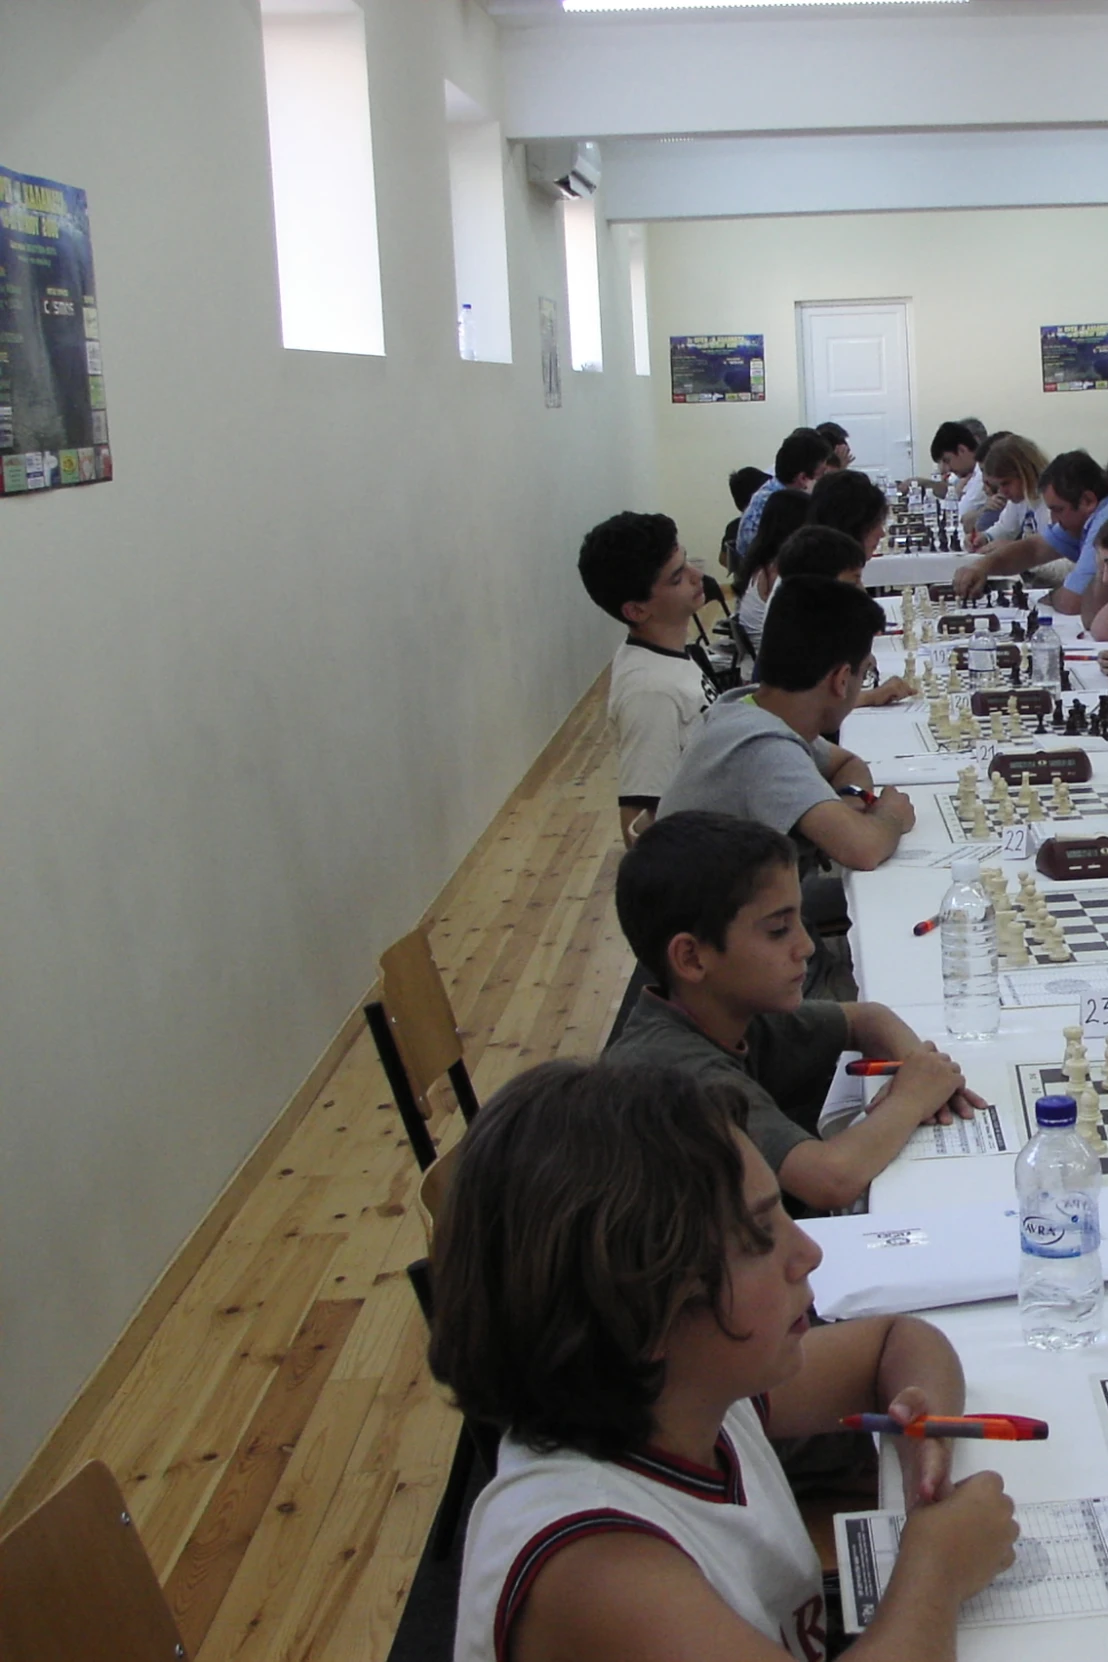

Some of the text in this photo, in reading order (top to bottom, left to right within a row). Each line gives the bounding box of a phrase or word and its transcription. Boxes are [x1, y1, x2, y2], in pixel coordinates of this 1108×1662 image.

[980, 745, 996, 760] 21
[1004, 830, 1024, 852] 22
[1025, 1222, 1057, 1237] AVRA
